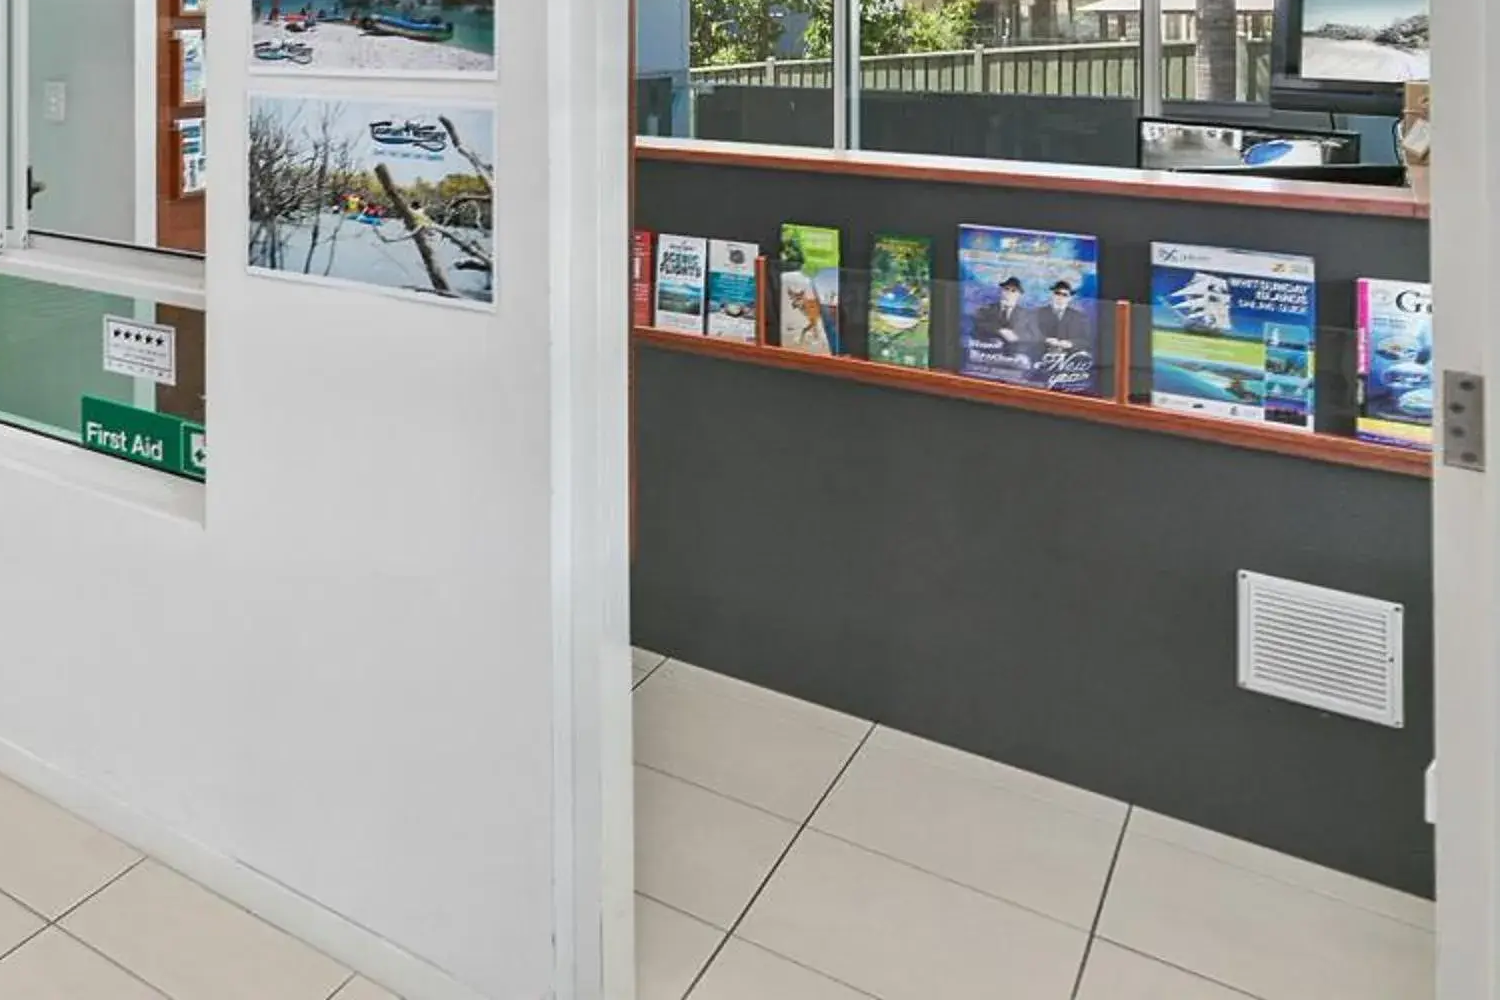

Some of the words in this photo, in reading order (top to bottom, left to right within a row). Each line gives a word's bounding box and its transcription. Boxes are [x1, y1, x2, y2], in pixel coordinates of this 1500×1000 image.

[1230, 277, 1308, 293] WHITSUNDAY
[86, 420, 128, 452] First
[131, 433, 163, 461] Aid
